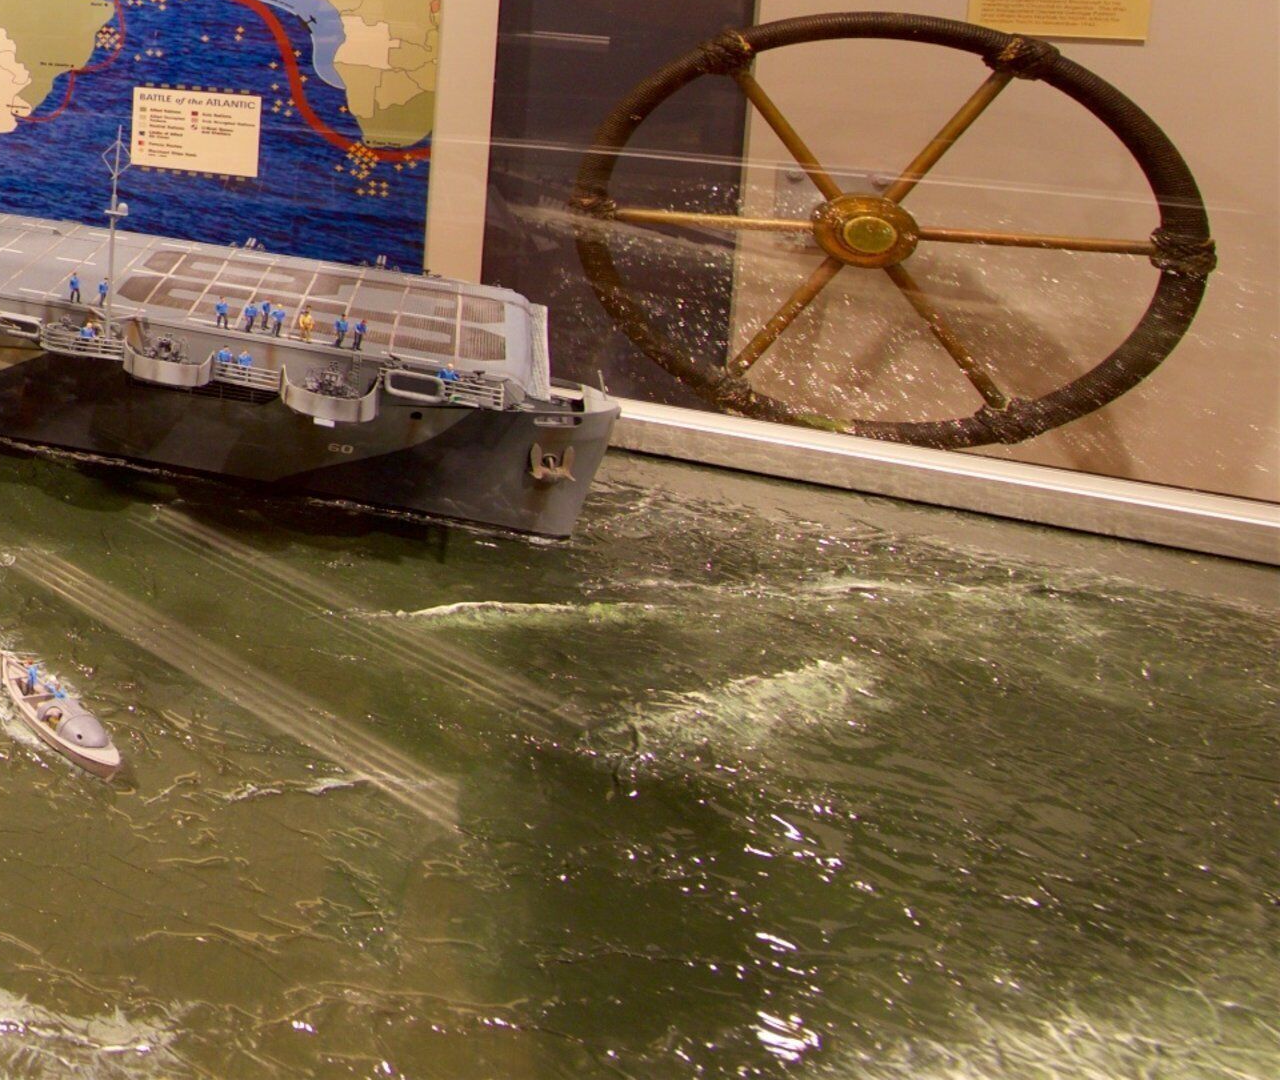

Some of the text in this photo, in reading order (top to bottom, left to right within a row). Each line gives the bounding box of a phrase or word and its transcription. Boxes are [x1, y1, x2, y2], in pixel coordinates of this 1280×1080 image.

[139, 92, 256, 110] BATTLE of the ATLANTIC
